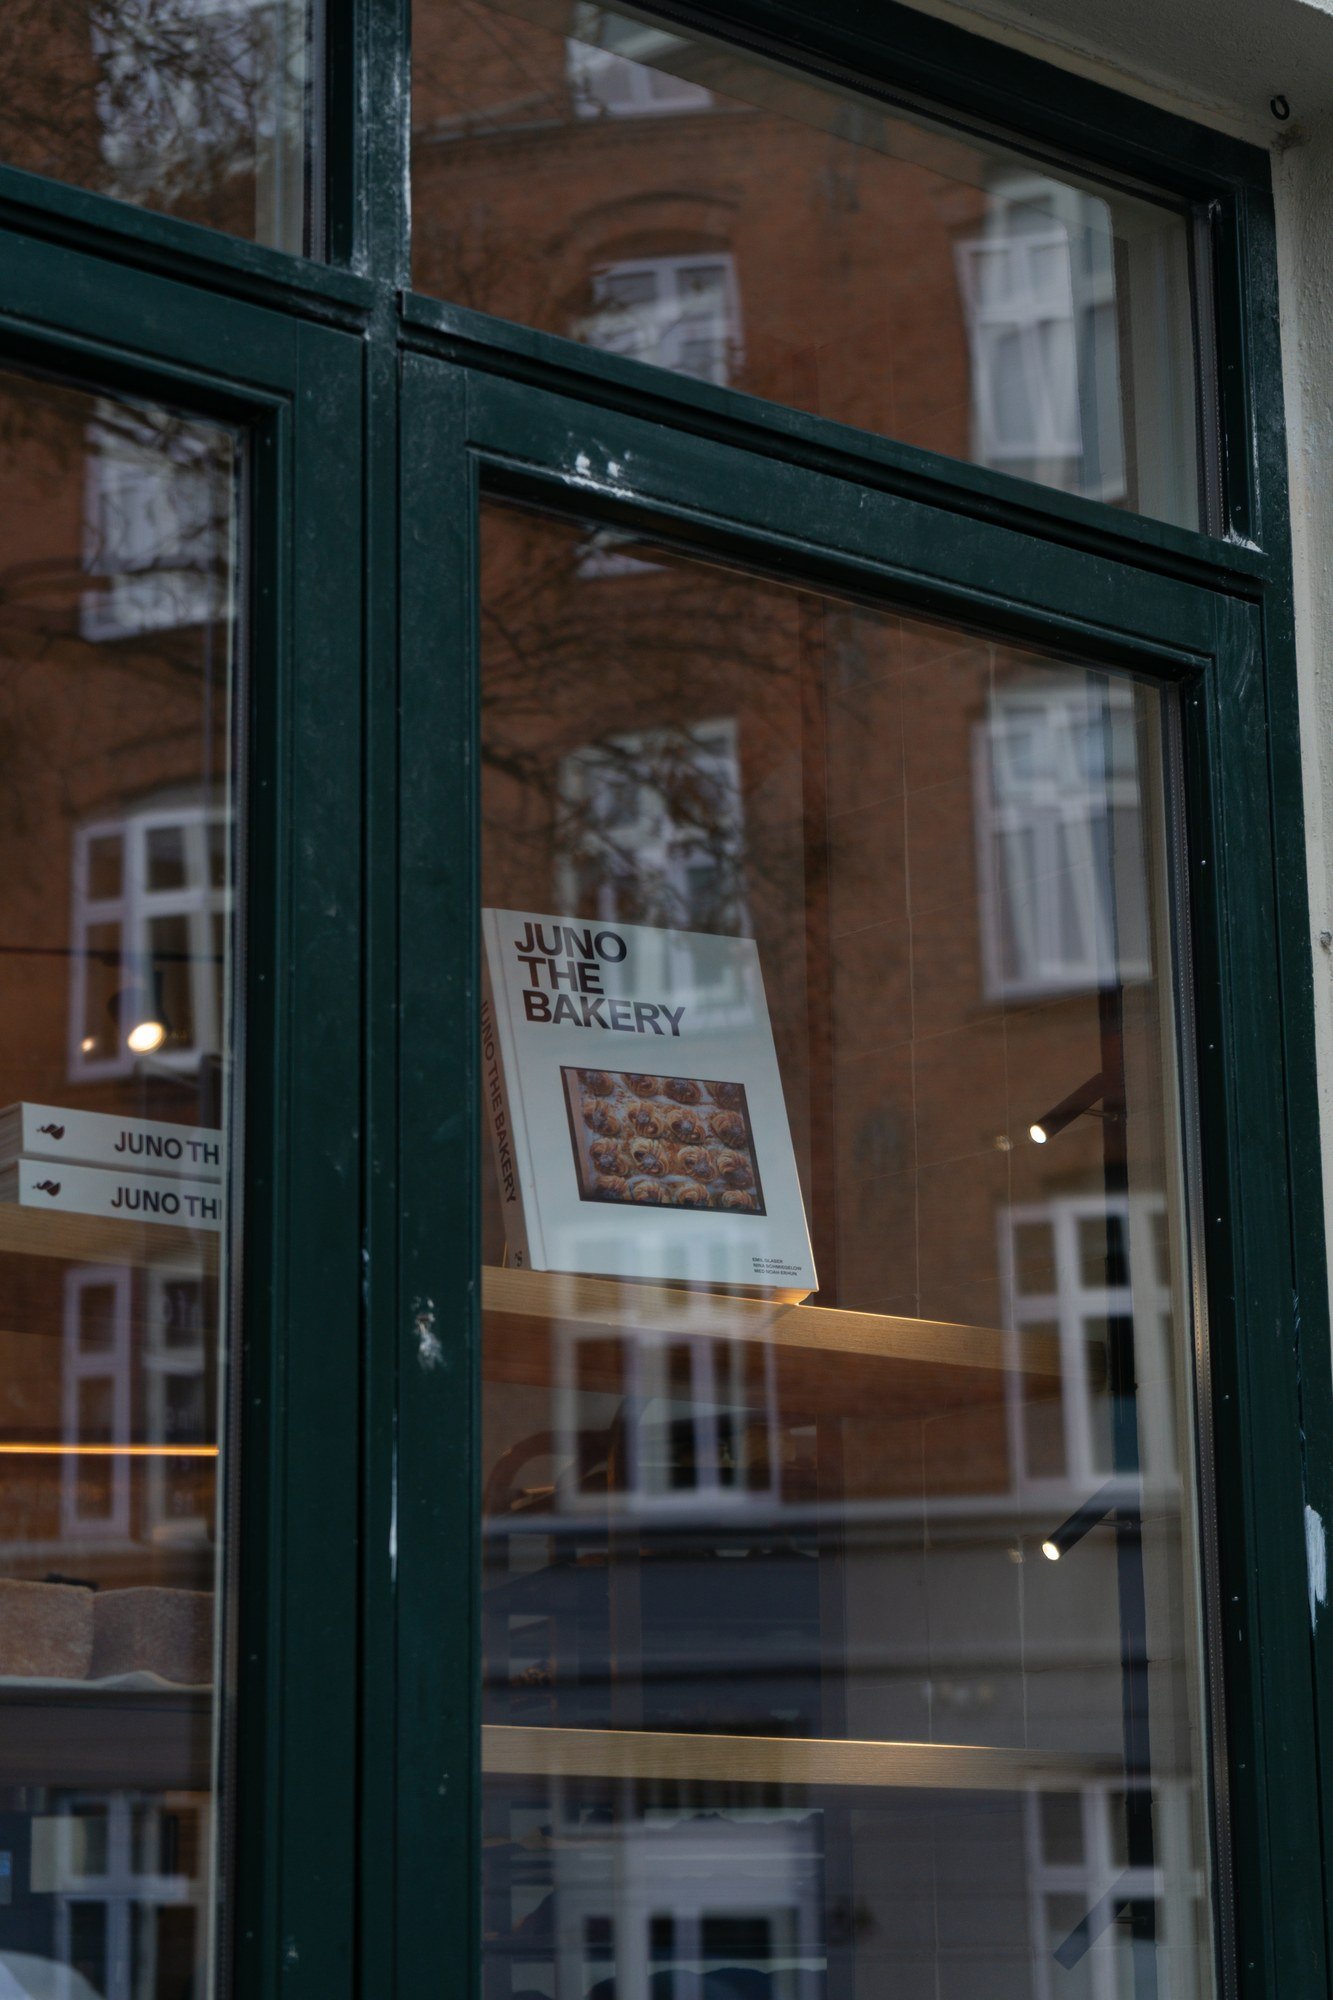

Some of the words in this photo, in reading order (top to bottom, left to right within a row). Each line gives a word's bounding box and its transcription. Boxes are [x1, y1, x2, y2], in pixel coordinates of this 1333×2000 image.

[514, 922, 628, 963] JUNO
[517, 955, 604, 995] THE
[522, 989, 686, 1037] BAKERY
[488, 1061, 502, 1112] THE
[114, 1131, 183, 1160] JUNO
[186, 1140, 222, 1166] TH
[494, 1111, 516, 1202] BAKERY
[111, 1187, 180, 1215] JUNO
[183, 1194, 222, 1220] TH
